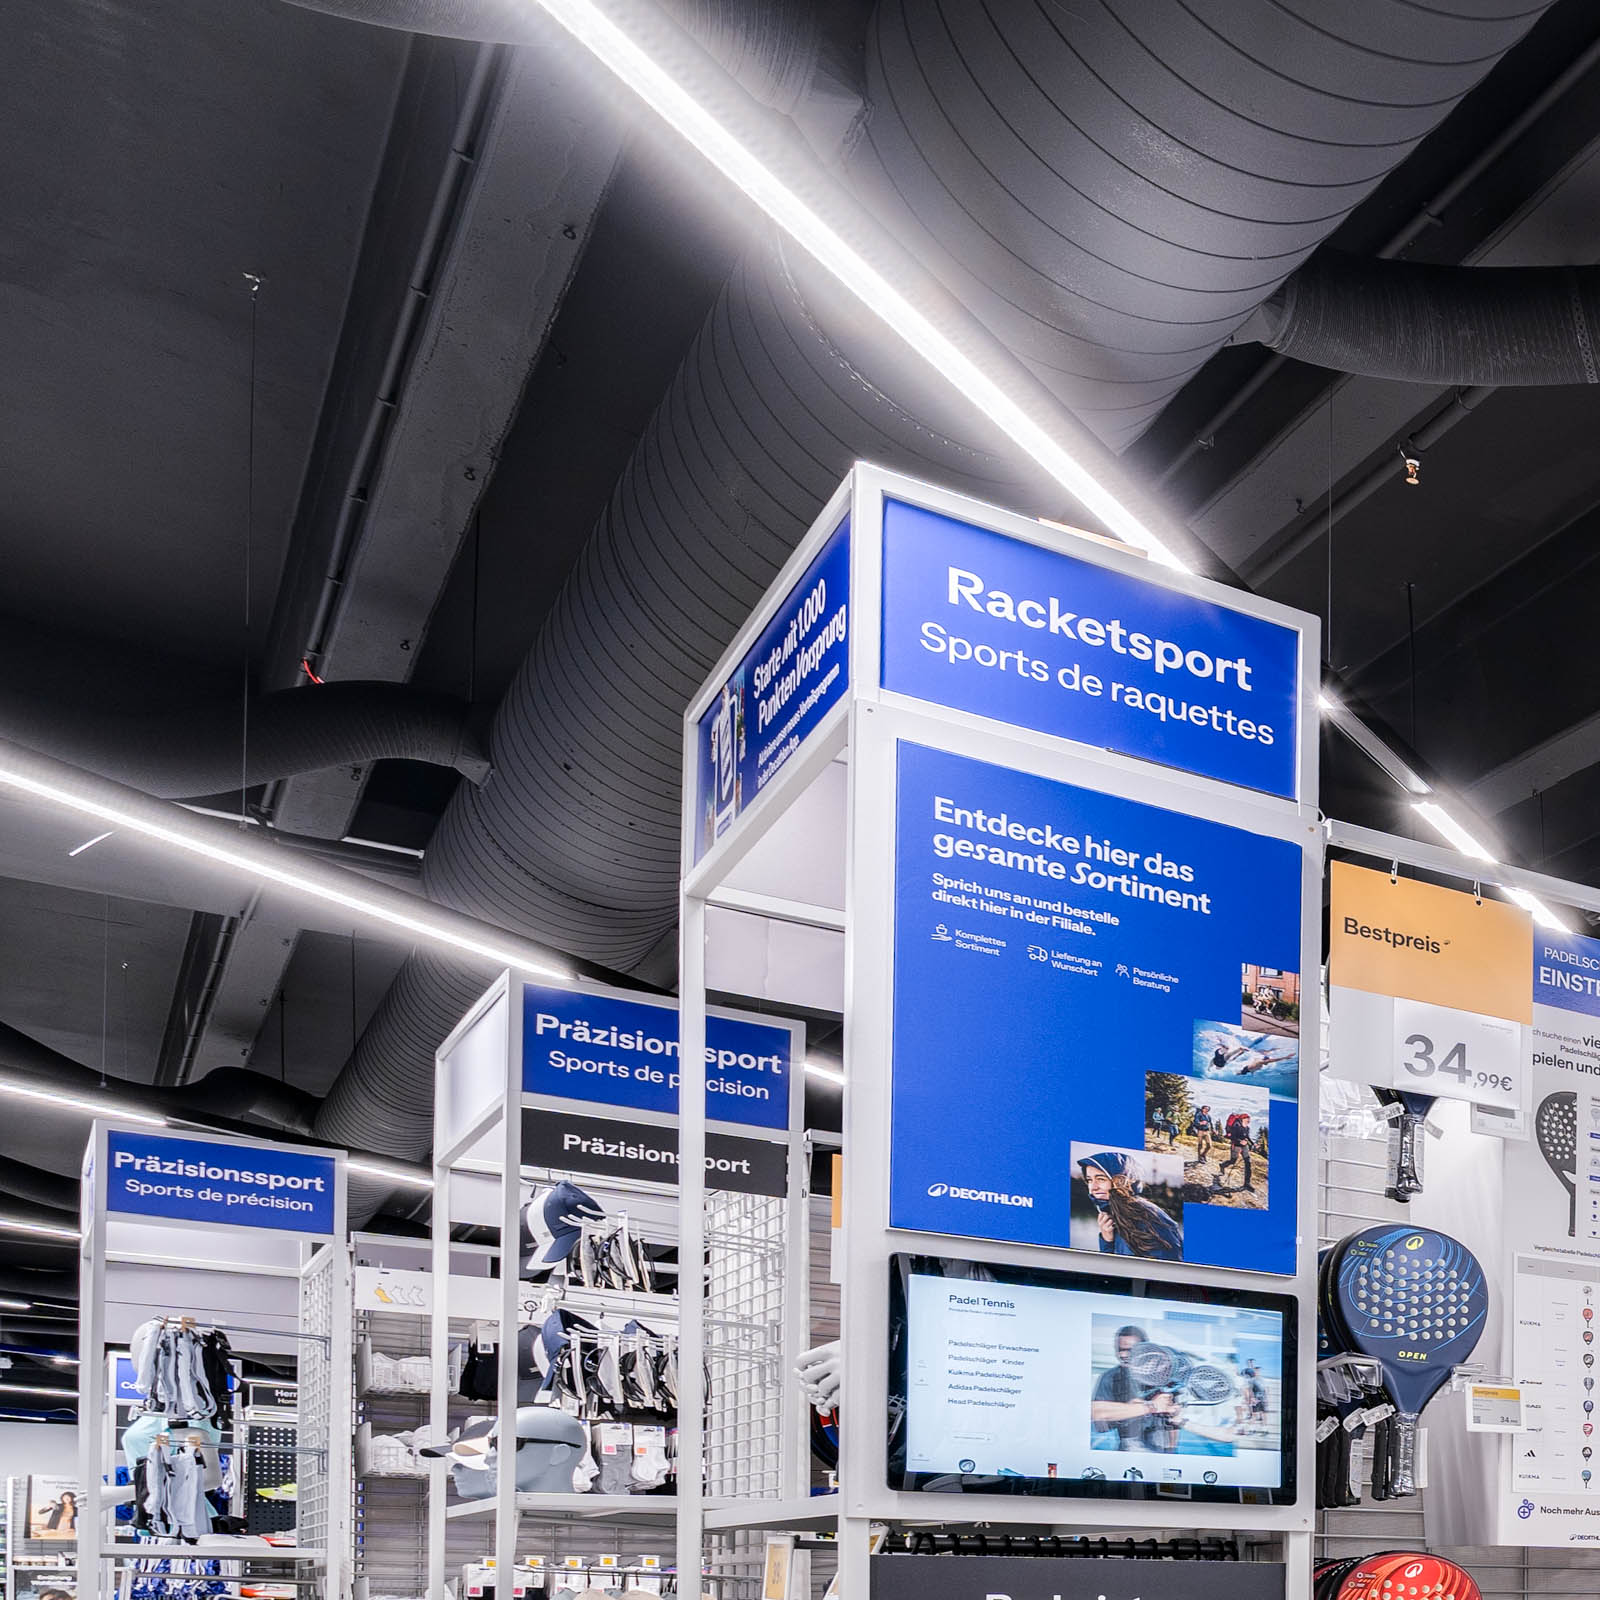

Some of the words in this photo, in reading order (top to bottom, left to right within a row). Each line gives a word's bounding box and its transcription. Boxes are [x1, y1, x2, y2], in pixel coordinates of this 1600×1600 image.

[754, 648, 781, 698] Starte
[798, 578, 826, 640] 1.000
[947, 566, 1252, 692] Racketsport
[758, 668, 797, 733] Punkten
[796, 604, 846, 686] Vorsprung
[920, 621, 1049, 682] Sports
[1057, 663, 1103, 696] de
[1110, 682, 1275, 747] raquettes
[935, 795, 1080, 855] Entdecke
[1085, 835, 1140, 869] hier
[1144, 853, 1194, 882] das
[933, 833, 1066, 880] gesamte
[1070, 862, 1211, 915] Sortiment
[932, 872, 982, 895] Sprich
[985, 887, 1011, 902] uns
[1013, 892, 1032, 907] an
[1033, 897, 1061, 913] und
[1063, 903, 1119, 926] bestelle
[932, 889, 977, 909] direkt
[980, 899, 1009, 917] hier
[1010, 905, 1023, 920] in
[1025, 909, 1050, 925] der
[1052, 915, 1096, 936] Filiale.
[955, 928, 1006, 948] Komplettes
[1344, 916, 1440, 954] Bestpreis
[955, 939, 1000, 956] Sortiment
[1051, 950, 1090, 966] Lieferung
[1092, 959, 1102, 967] an
[1052, 960, 1098, 976] Wunschort
[1133, 967, 1178, 983] Persönliche
[1133, 976, 1170, 992] Beratung
[536, 1013, 782, 1074] Präzisionsport
[549, 1051, 629, 1078] Sports
[634, 1065, 664, 1083] de
[1404, 1034, 1513, 1092] 34,99€
[115, 1152, 324, 1192] Präzisionssport
[125, 1179, 194, 1198] Sports
[198, 1188, 223, 1201] de
[227, 1192, 313, 1212] précision
[950, 1186, 1032, 1208] DECATHLON
[949, 1295, 979, 1305] Padel
[982, 1298, 1015, 1309] Tennis
[949, 1340, 997, 1350] Padelschläger
[998, 1344, 1039, 1352] Erwachsene
[1399, 1351, 1428, 1360] OPEN
[948, 1354, 997, 1364] Padelschläger
[976, 1371, 1023, 1380] Padelschläger
[974, 1385, 1021, 1395] Padelschläger
[968, 1400, 1016, 1408] Padelschläger
[1540, 1506, 1561, 1515] Noch
[1562, 1507, 1584, 1516] mehr
